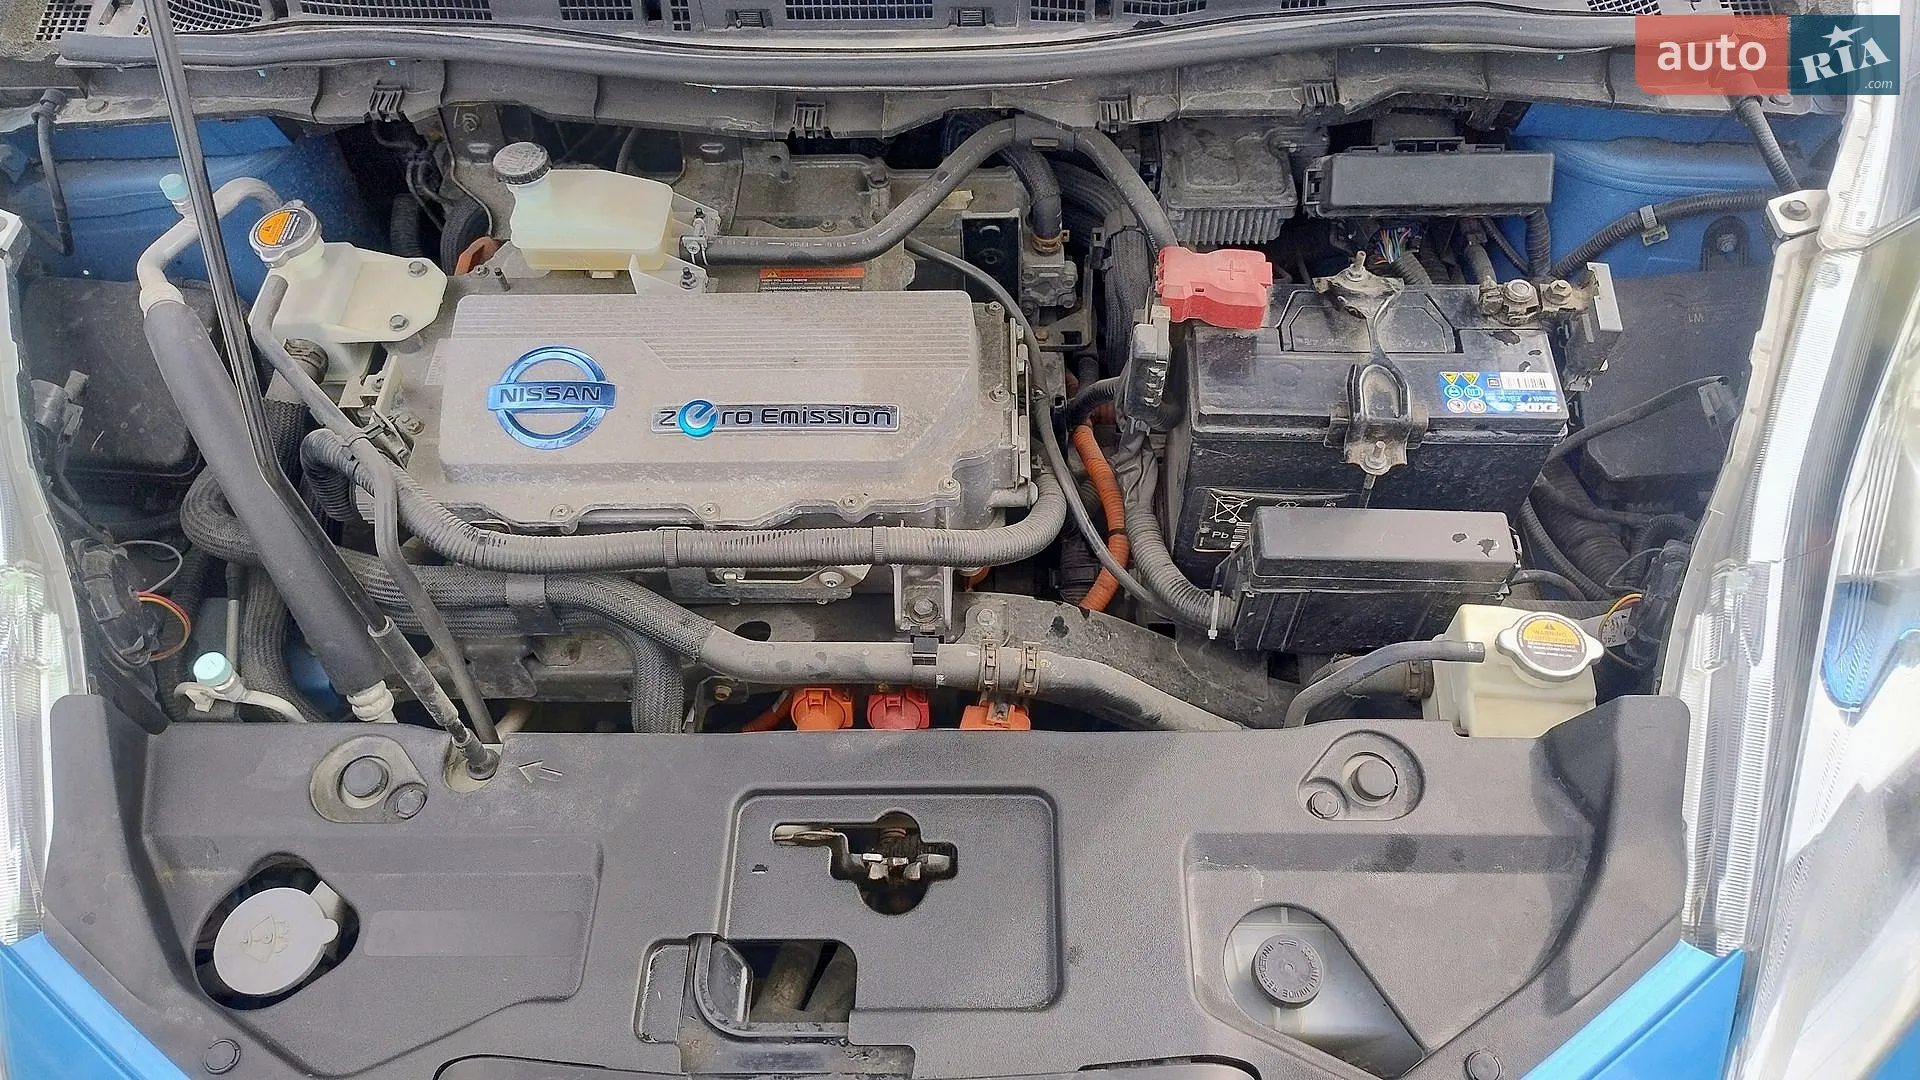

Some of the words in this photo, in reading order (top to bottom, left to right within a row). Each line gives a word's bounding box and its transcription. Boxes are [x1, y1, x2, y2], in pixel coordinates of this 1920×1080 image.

[500, 385, 601, 403] NISSAN
[761, 406, 891, 426] Emission
[1211, 531, 1229, 539] Pb
